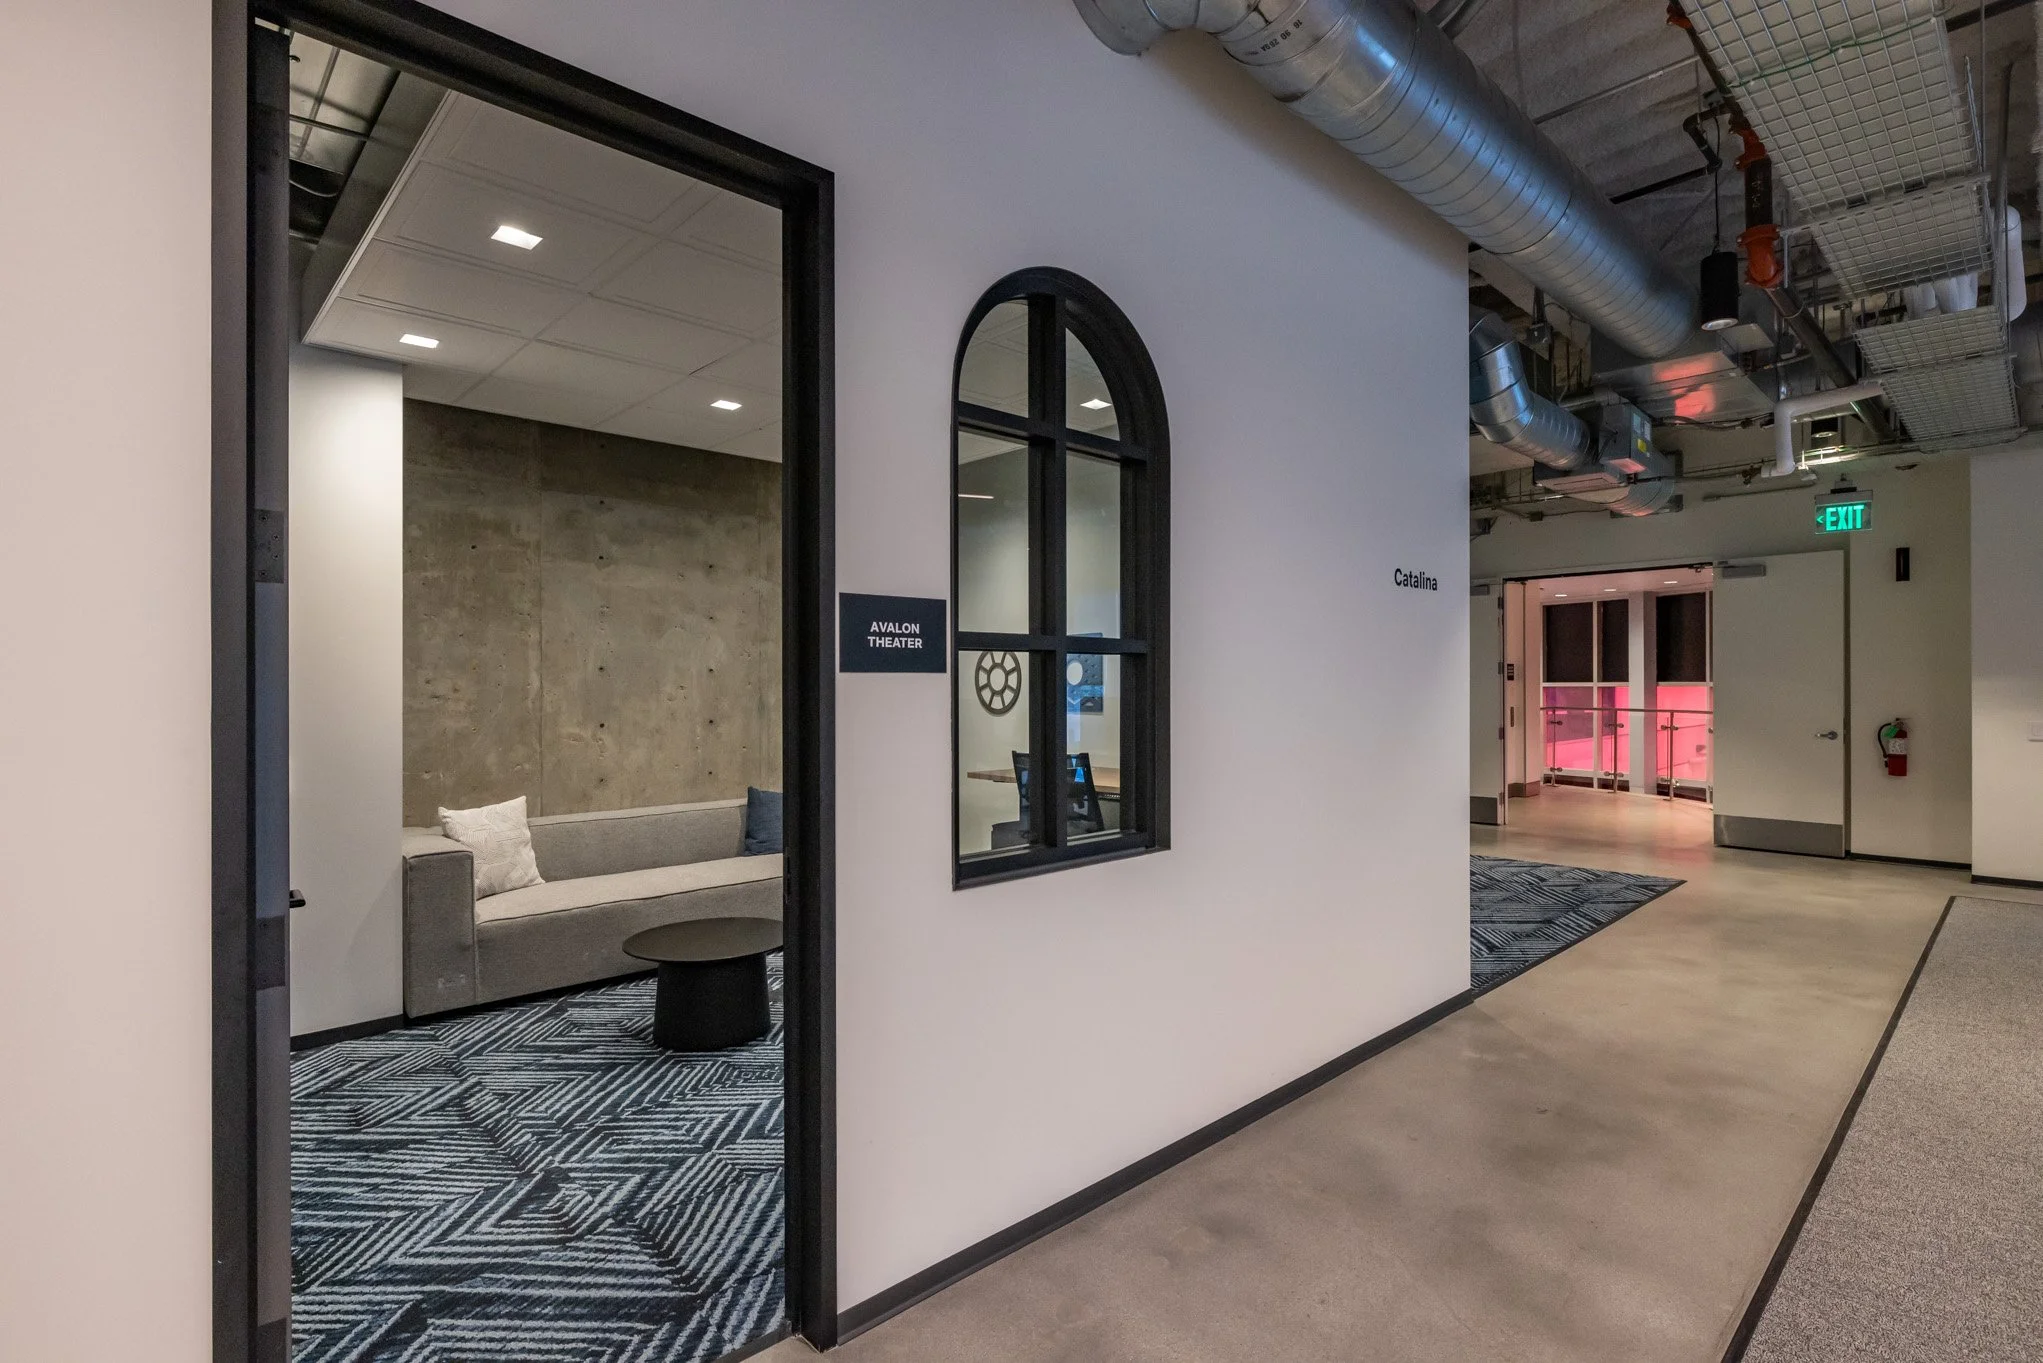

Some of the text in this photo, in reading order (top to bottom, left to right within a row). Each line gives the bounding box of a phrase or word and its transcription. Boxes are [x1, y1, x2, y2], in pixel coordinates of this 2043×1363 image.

[1825, 504, 1865, 531] EXIT
[1394, 567, 1438, 591] Catalina
[869, 621, 920, 634] AVALON
[867, 636, 923, 649] THEATER
